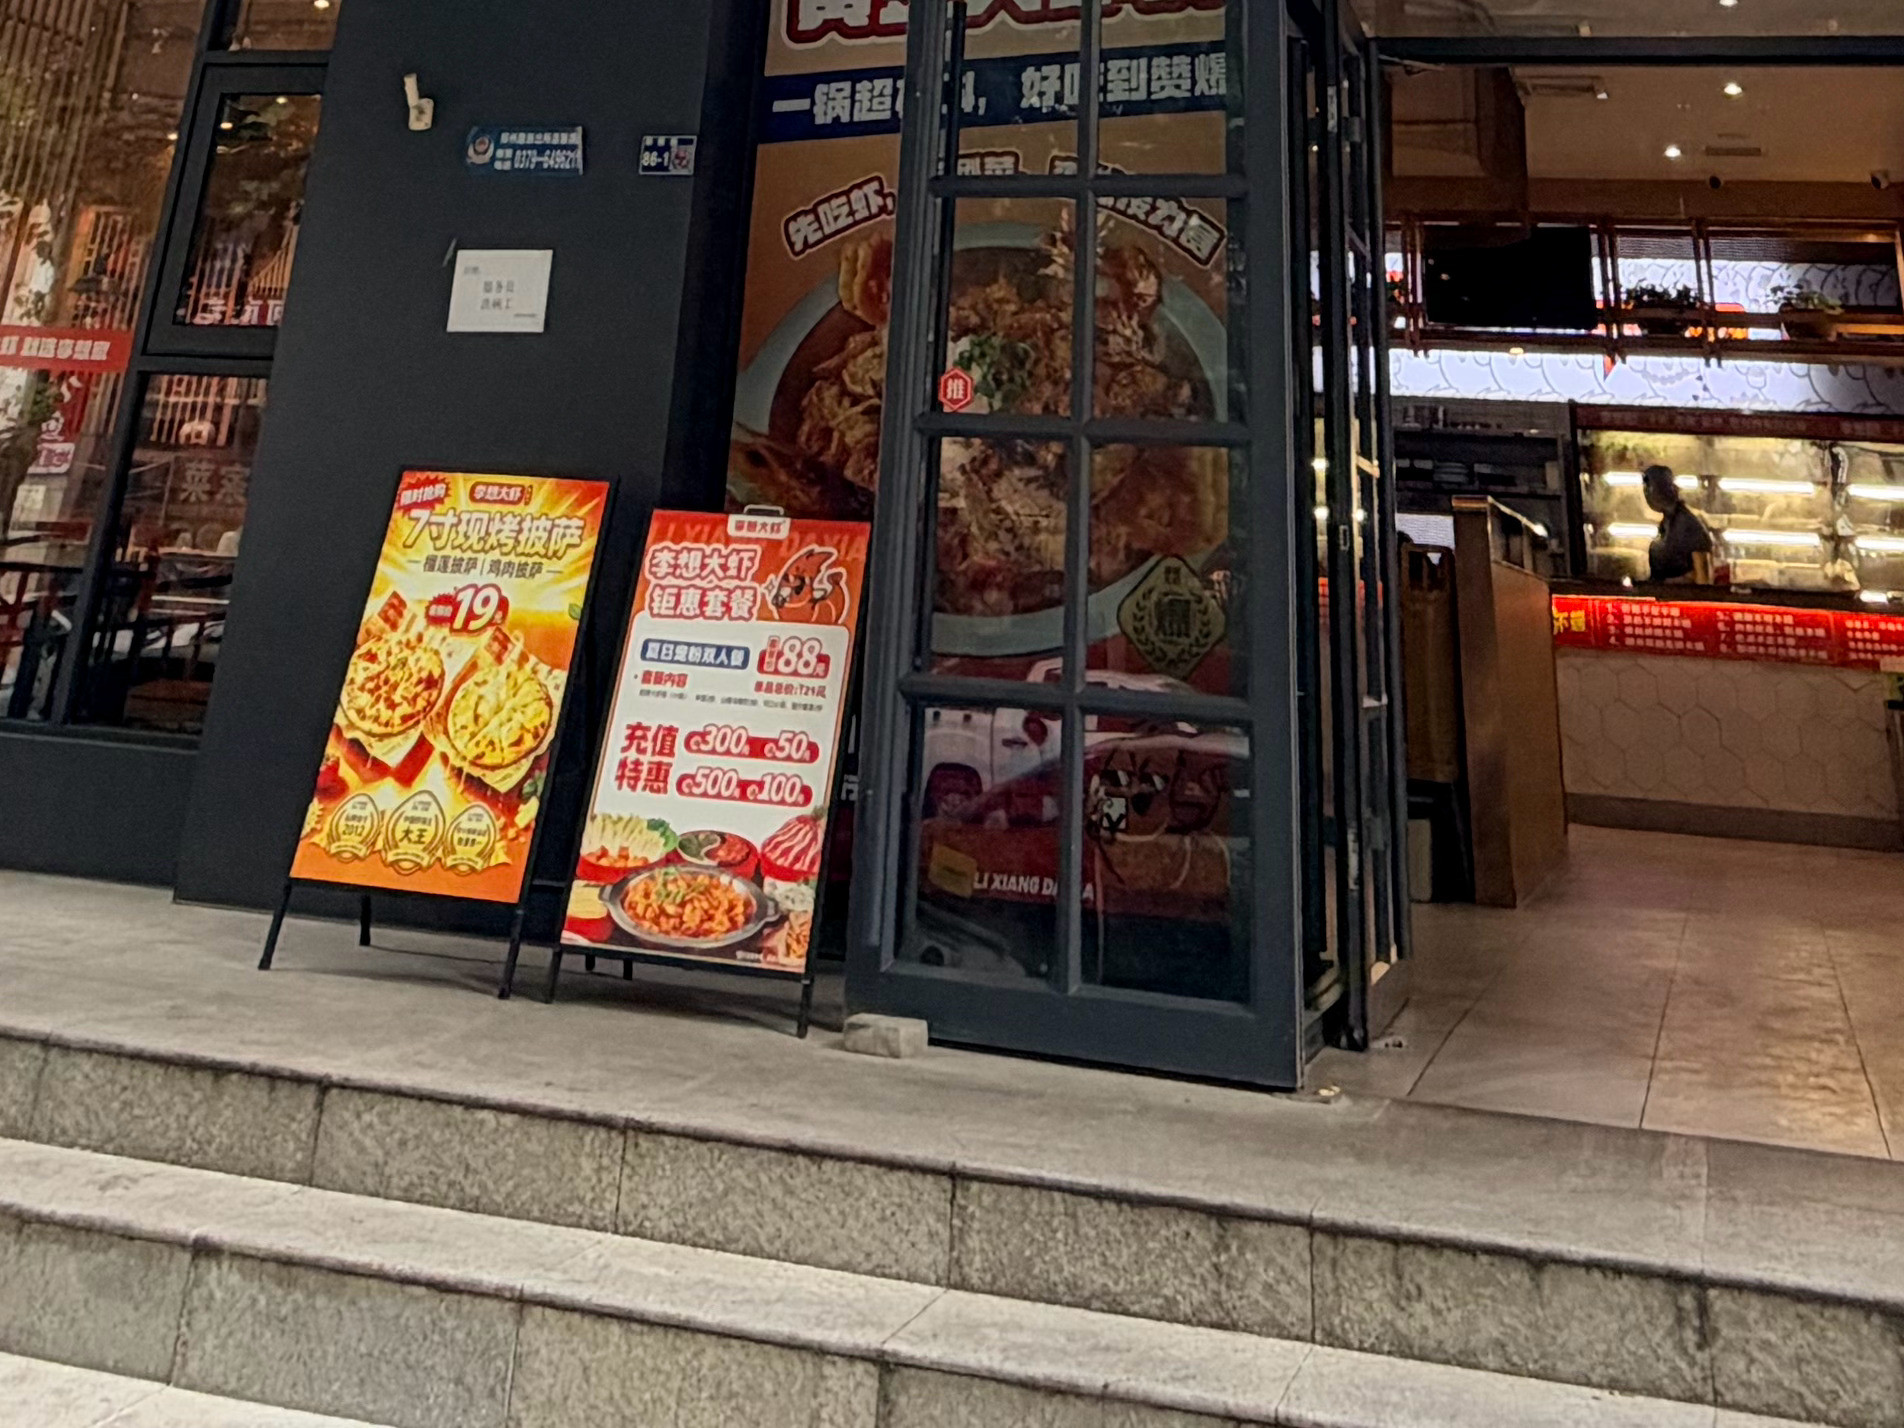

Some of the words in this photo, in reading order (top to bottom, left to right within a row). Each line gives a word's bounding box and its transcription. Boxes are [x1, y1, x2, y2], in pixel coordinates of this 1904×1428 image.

[403, 506, 585, 558] 7寸现烤披萨
[651, 547, 754, 580] 李想大虾
[651, 585, 754, 620] 钜惠套餐
[621, 722, 679, 758] 充值
[615, 756, 673, 794] 特惠
[399, 826, 428, 844] 大王
